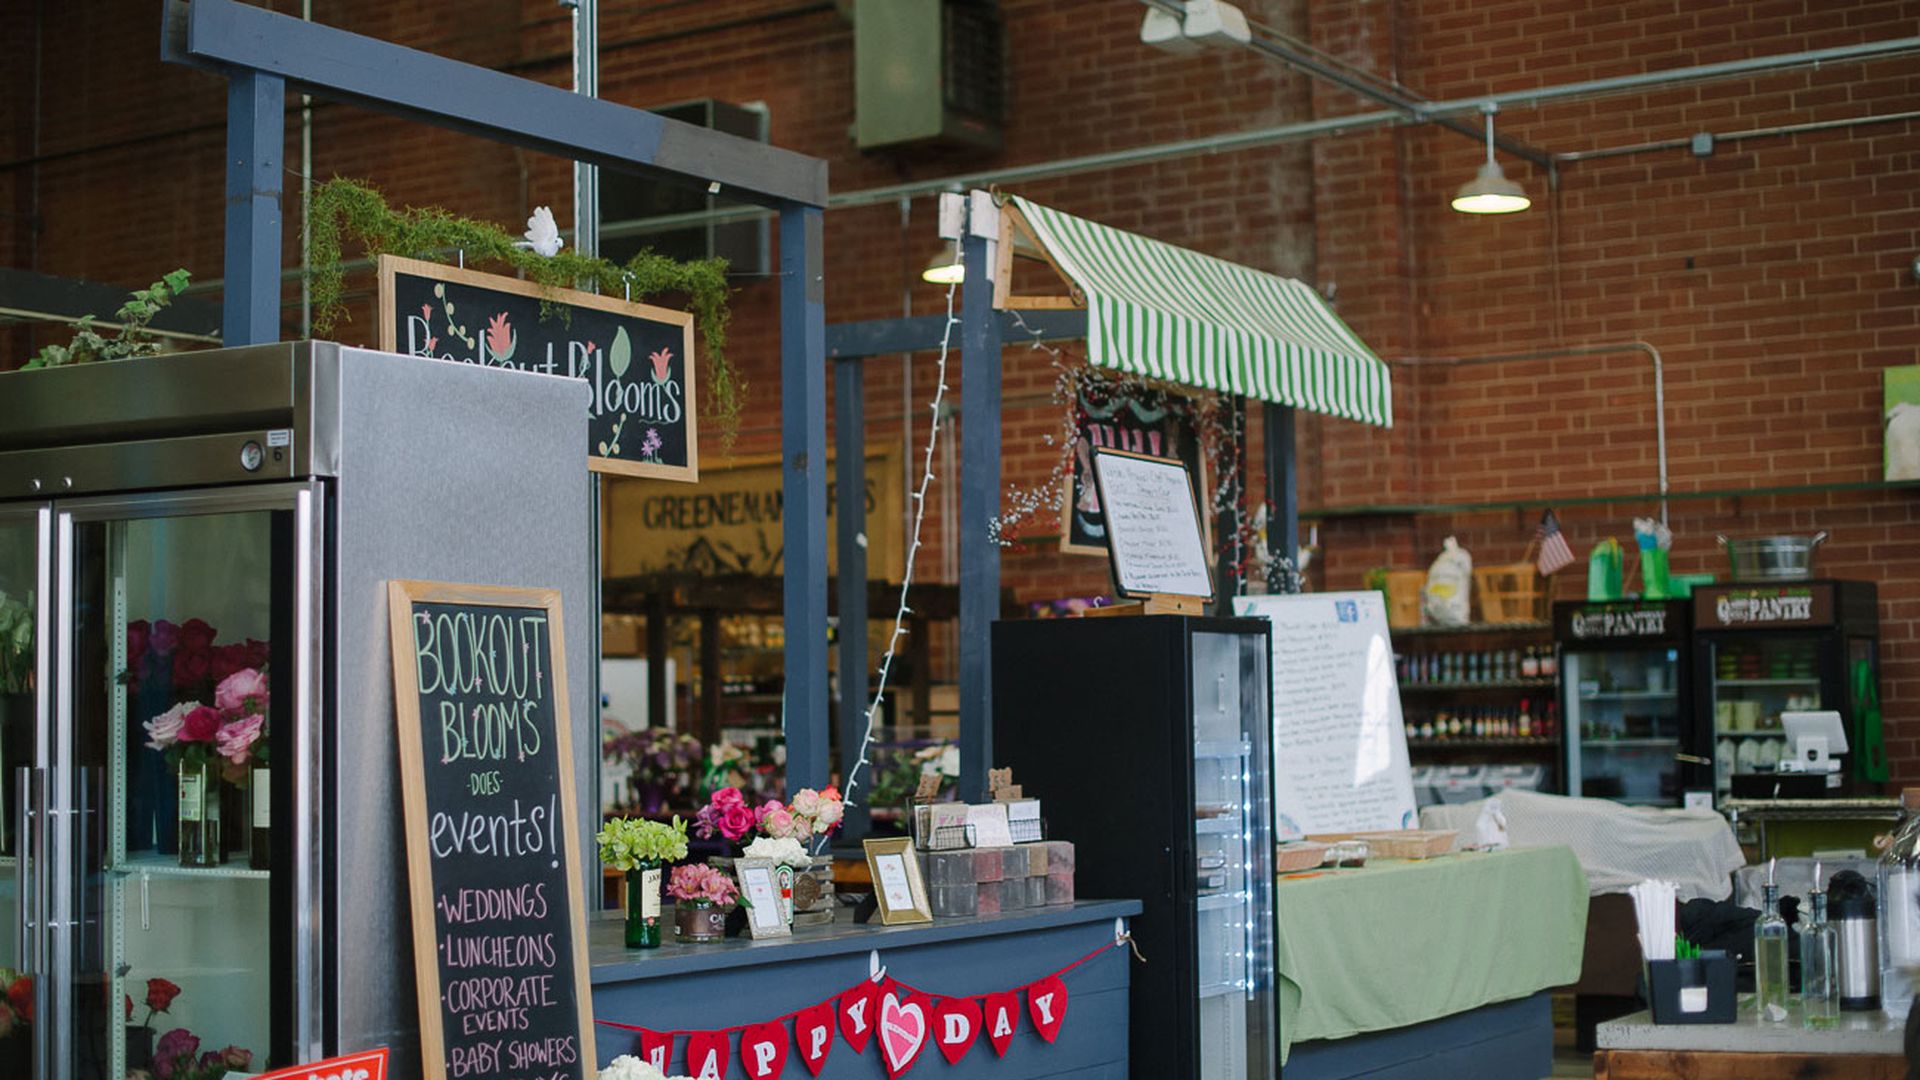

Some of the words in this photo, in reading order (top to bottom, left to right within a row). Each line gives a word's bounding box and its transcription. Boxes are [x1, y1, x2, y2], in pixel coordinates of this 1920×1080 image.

[1603, 610, 1667, 636] PANTRY
[1750, 596, 1813, 622] PANTRY
[413, 612, 548, 700] BOOKOUT
[440, 700, 541, 763] BLOOMS
[430, 793, 560, 869] events!
[442, 883, 548, 923] WEDDINGS
[447, 933, 557, 968] LUNCHEONS
[448, 974, 557, 1013] CORPORATE
[462, 1007, 530, 1036] EVENTS
[943, 992, 1054, 1045] DAY
[452, 1039, 502, 1078] BABY
[508, 1036, 577, 1070] SHOWERS
